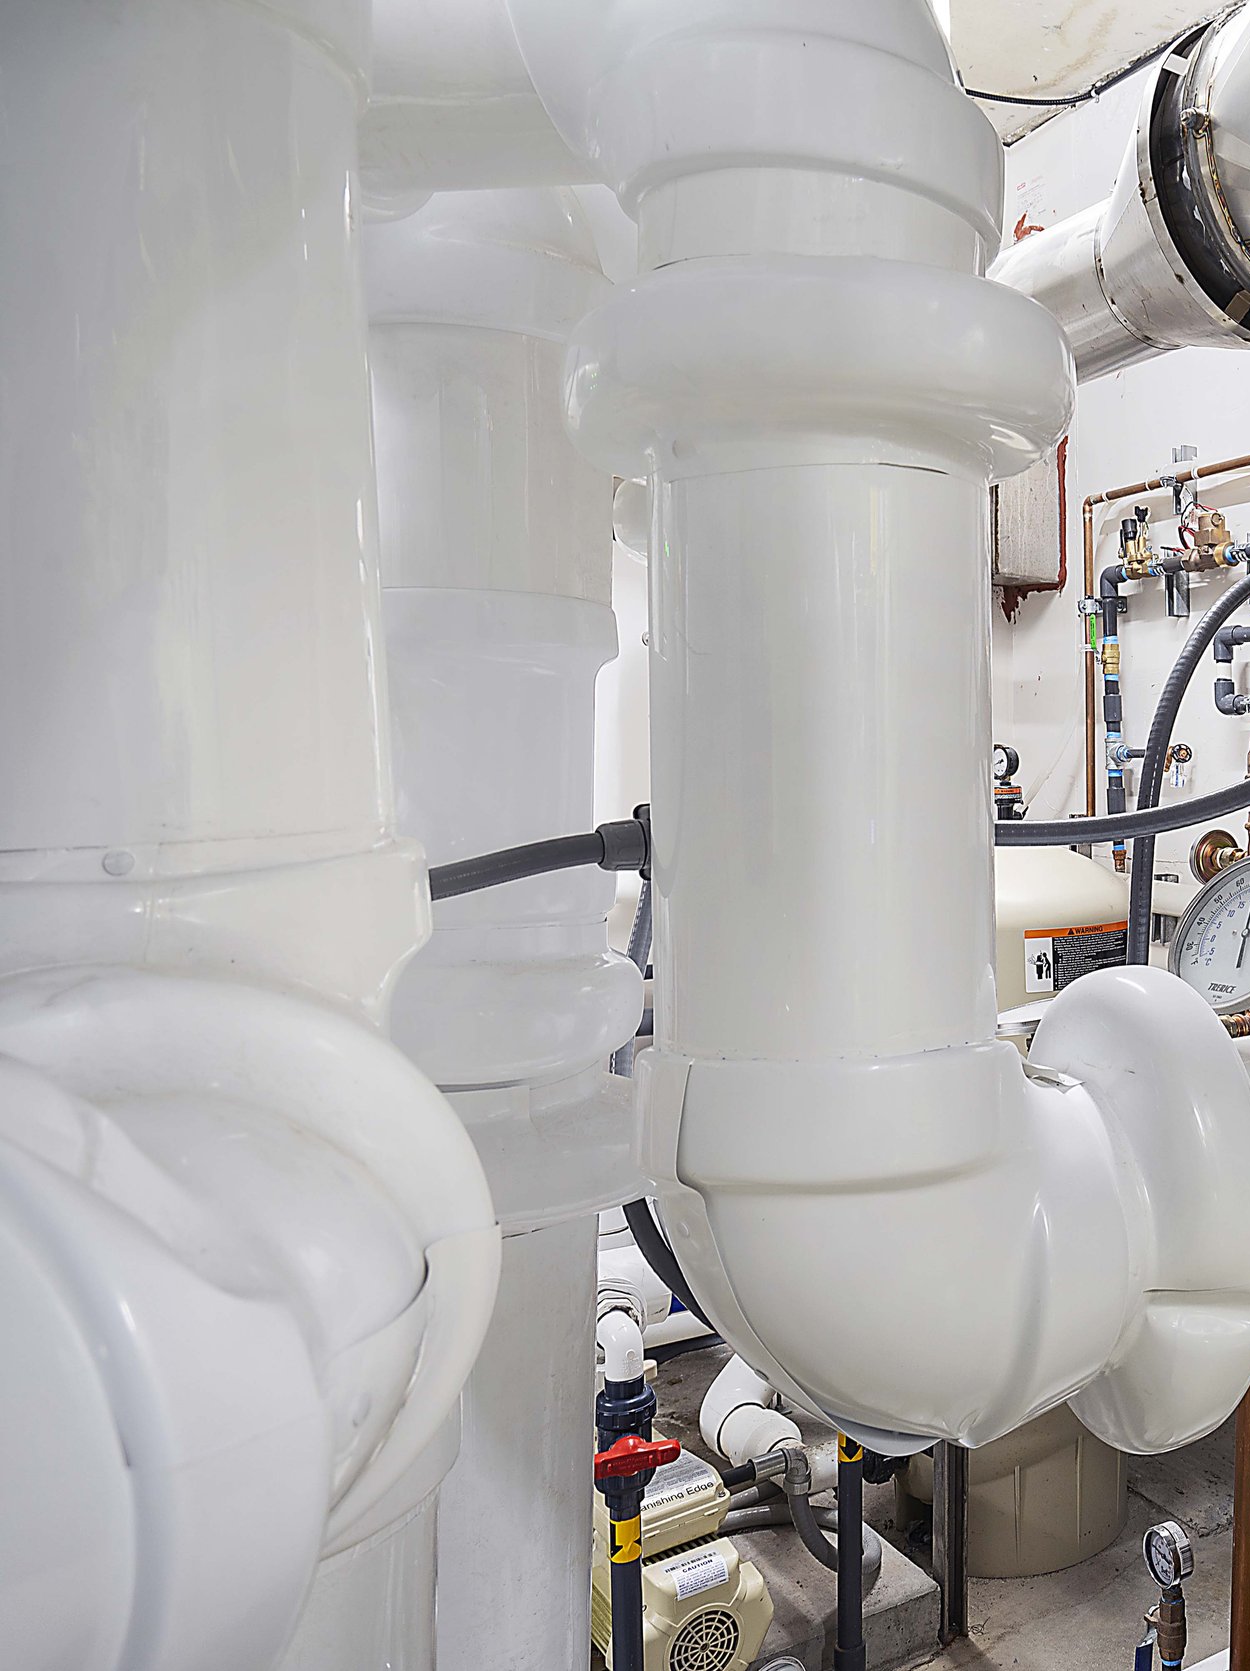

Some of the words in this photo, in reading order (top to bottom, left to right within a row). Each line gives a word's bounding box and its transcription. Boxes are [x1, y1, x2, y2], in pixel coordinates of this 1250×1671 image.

[1235, 877, 1245, 887] 60
[1237, 901, 1246, 909] 15
[1226, 909, 1236, 918] 10
[1216, 920, 1222, 929] 5
[1075, 926, 1103, 935] WARNING
[1210, 934, 1217, 943] 0
[1207, 982, 1236, 994] TRERICE
[640, 1491, 684, 1513] anishing
[686, 1481, 715, 1496] Edge
[682, 1559, 713, 1573] CAUTION
